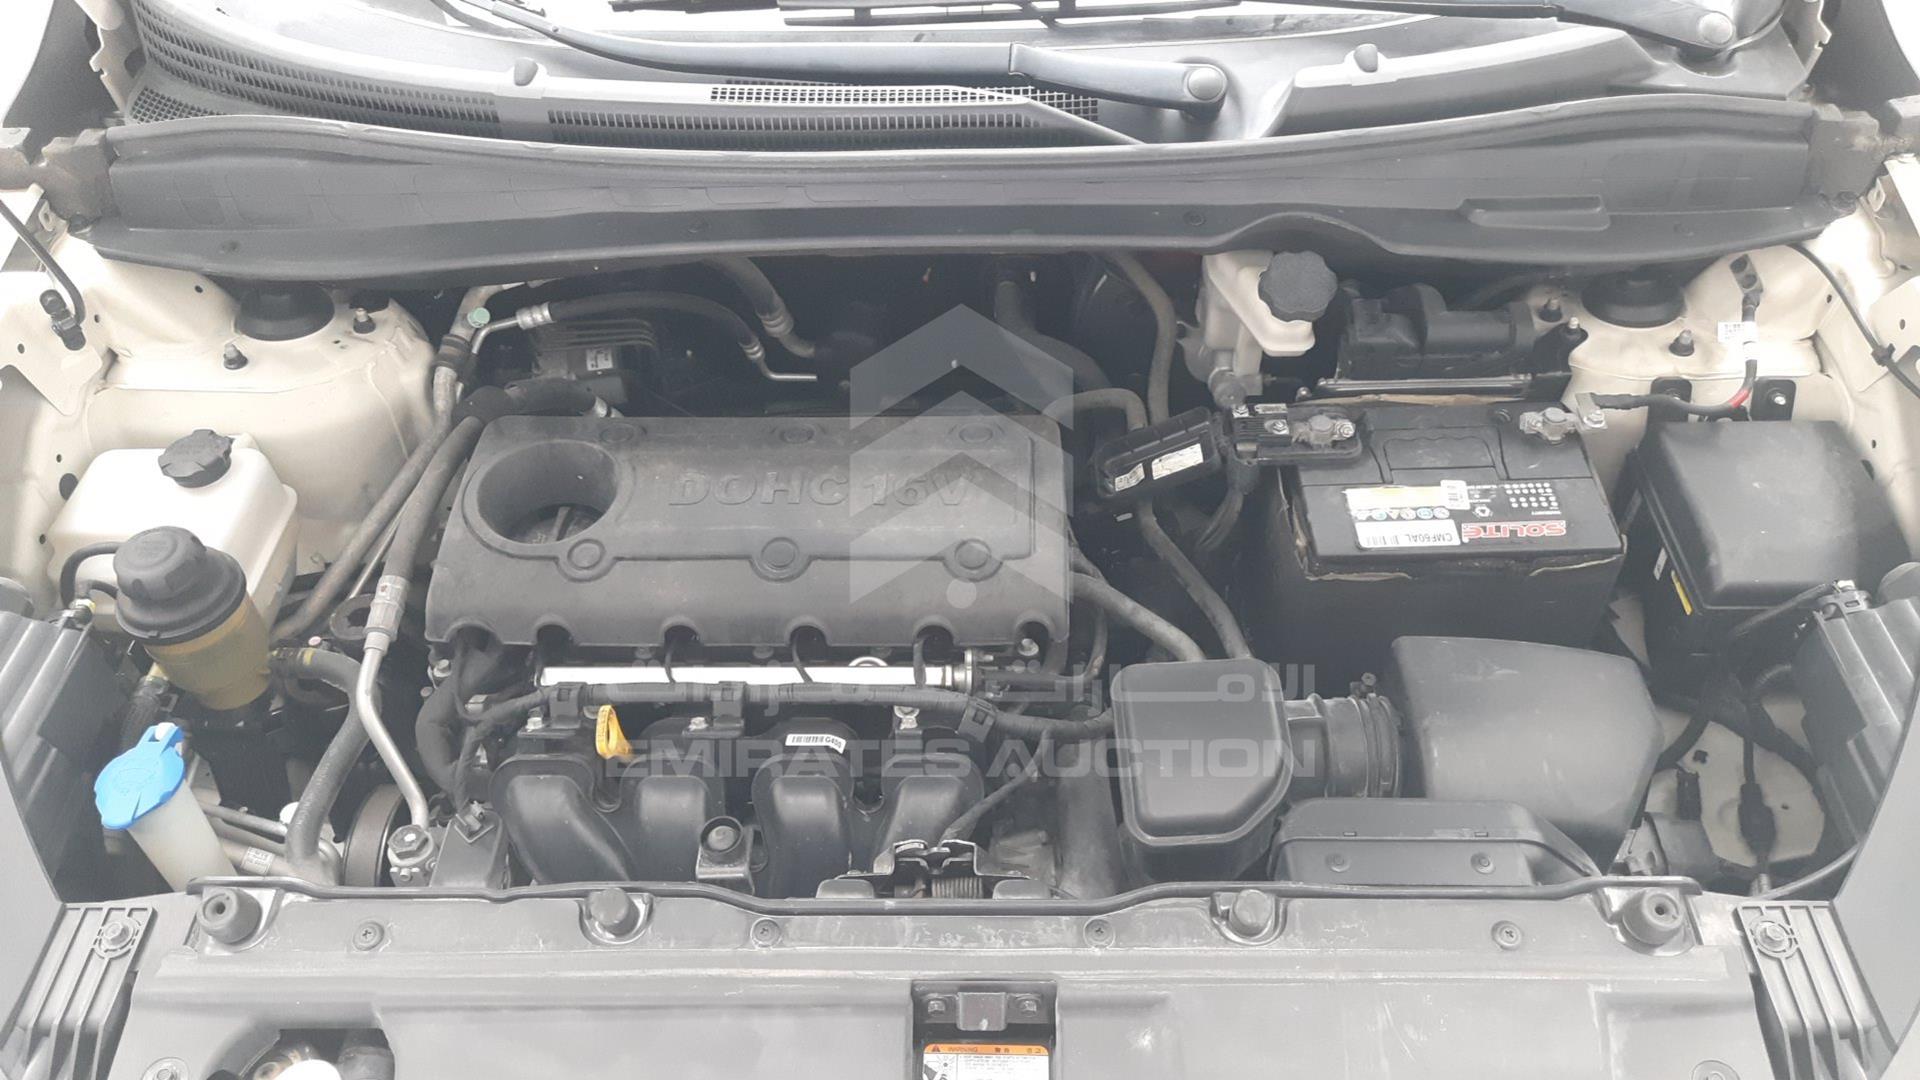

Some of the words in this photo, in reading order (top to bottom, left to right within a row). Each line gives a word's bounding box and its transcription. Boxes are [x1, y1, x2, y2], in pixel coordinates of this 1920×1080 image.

[668, 471, 848, 505] DOHC
[864, 472, 971, 506] 16V
[1464, 523, 1567, 538] SOLITE
